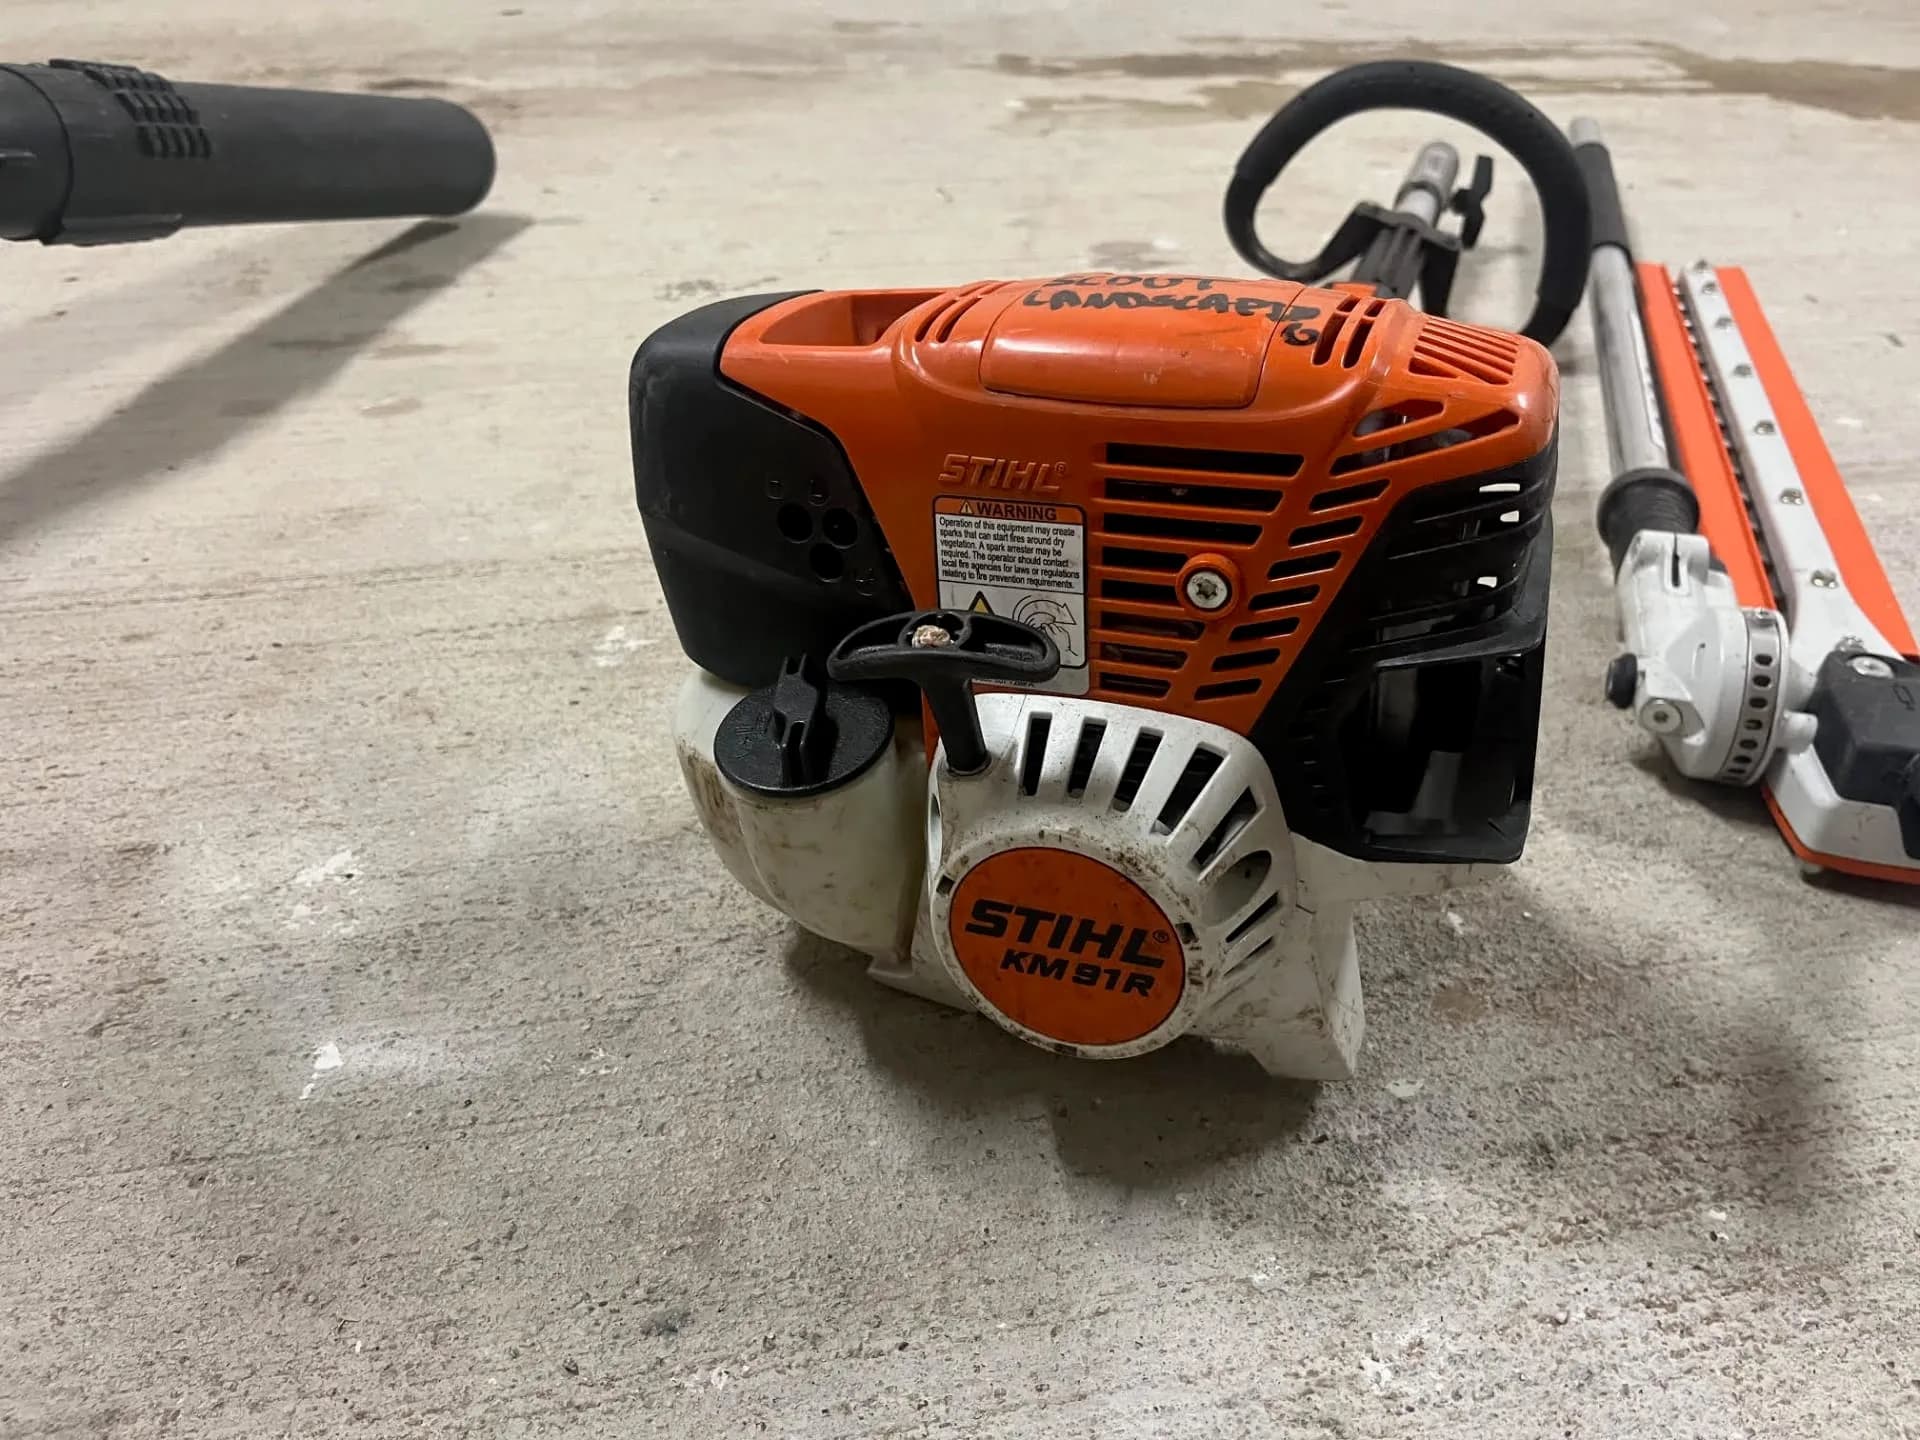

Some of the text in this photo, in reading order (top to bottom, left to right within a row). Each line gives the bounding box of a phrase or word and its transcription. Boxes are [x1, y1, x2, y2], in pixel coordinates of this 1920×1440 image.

[938, 453, 1060, 491] STIHL
[977, 502, 1057, 520] WARNING
[939, 517, 1075, 536] Operation of this equipment may create
[940, 528, 1065, 548] sparks that can start fires around dry
[941, 539, 976, 549] vegetation.
[987, 543, 1005, 553] spark
[1008, 545, 1034, 554] arrester
[1036, 548, 1050, 557] may
[941, 550, 1068, 567] required. The operator should contact
[942, 570, 966, 580] relating
[977, 572, 987, 580] fire
[989, 574, 1024, 584] prevention
[1027, 577, 1074, 588] requirements.
[971, 562, 1001, 573] agencies
[1003, 564, 1013, 572] for
[1015, 565, 1029, 574] laws
[1041, 568, 1079, 579] regulations
[965, 898, 1164, 968] STIHL
[1001, 949, 1155, 997] KM 91R
